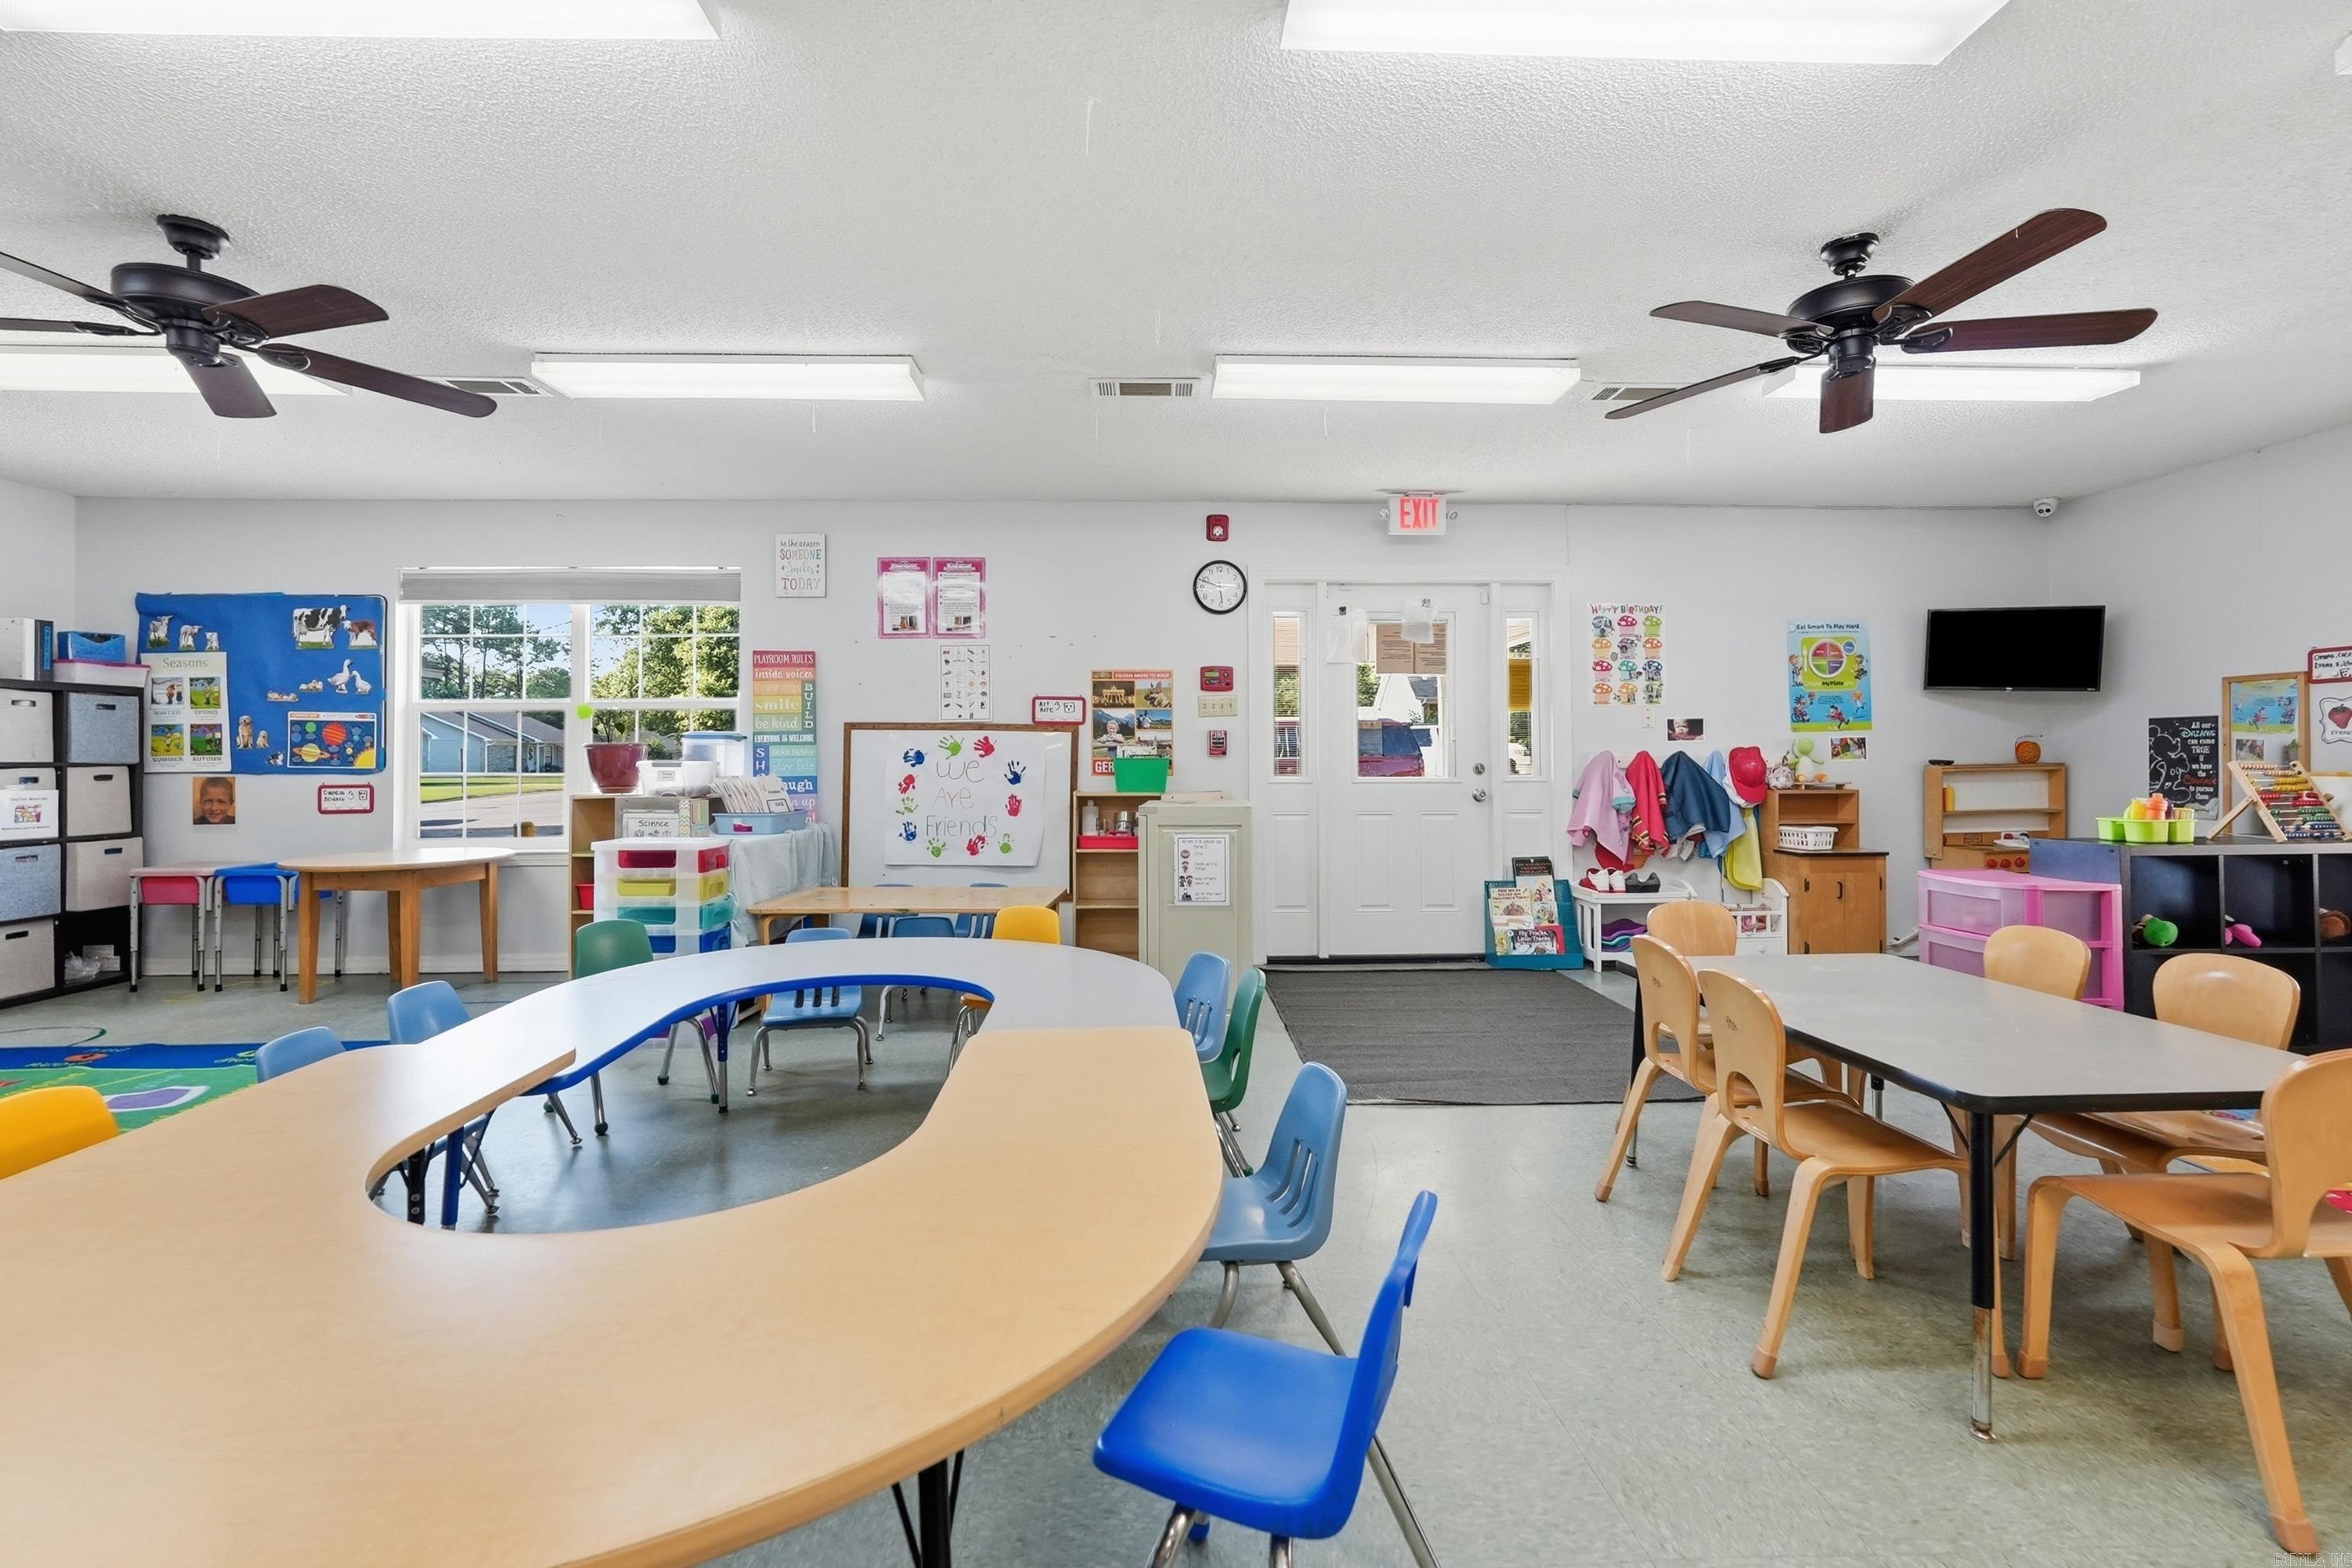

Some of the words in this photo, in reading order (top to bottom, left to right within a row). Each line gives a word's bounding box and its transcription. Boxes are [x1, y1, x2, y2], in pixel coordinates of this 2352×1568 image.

[1400, 498, 1439, 528] EXIT
[779, 548, 822, 560] SOMEONE
[781, 578, 821, 590] TODAY
[1621, 604, 1663, 615] BIRTHDAY!
[162, 657, 208, 669] Seasons
[754, 654, 789, 664] PLAYROOM
[792, 654, 814, 664] RULES
[755, 669, 783, 678] inside
[786, 669, 813, 678] voices
[754, 699, 798, 710] smile
[804, 683, 814, 728] BUILD
[755, 717, 769, 729] be
[771, 715, 798, 729] kind
[936, 760, 985, 783] We
[931, 786, 975, 810] Are
